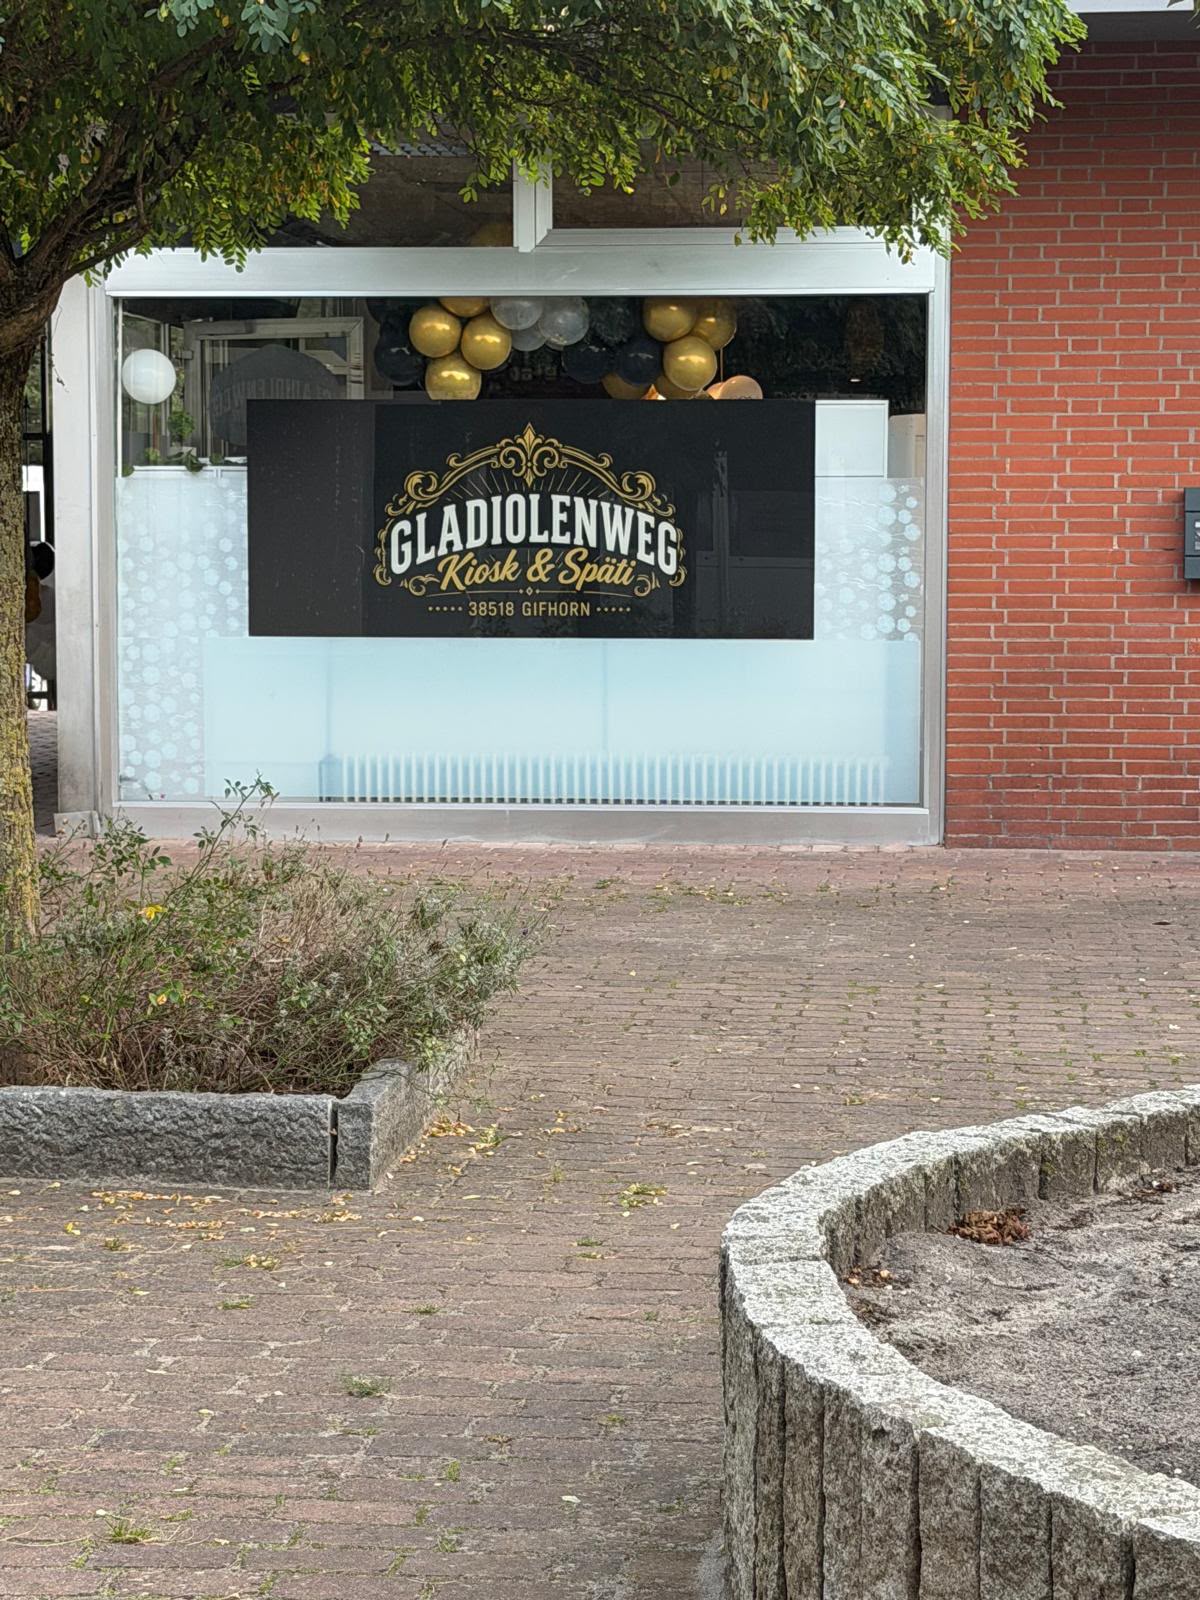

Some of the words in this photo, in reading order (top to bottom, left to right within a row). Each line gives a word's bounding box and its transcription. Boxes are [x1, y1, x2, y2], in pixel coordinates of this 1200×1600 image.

[390, 493, 678, 576] GLADIOLENWEG
[436, 549, 521, 592] Kiosk
[526, 547, 555, 583] &
[558, 547, 637, 592] Späti
[468, 601, 515, 617] 38518
[522, 601, 590, 617] GIFHORN
